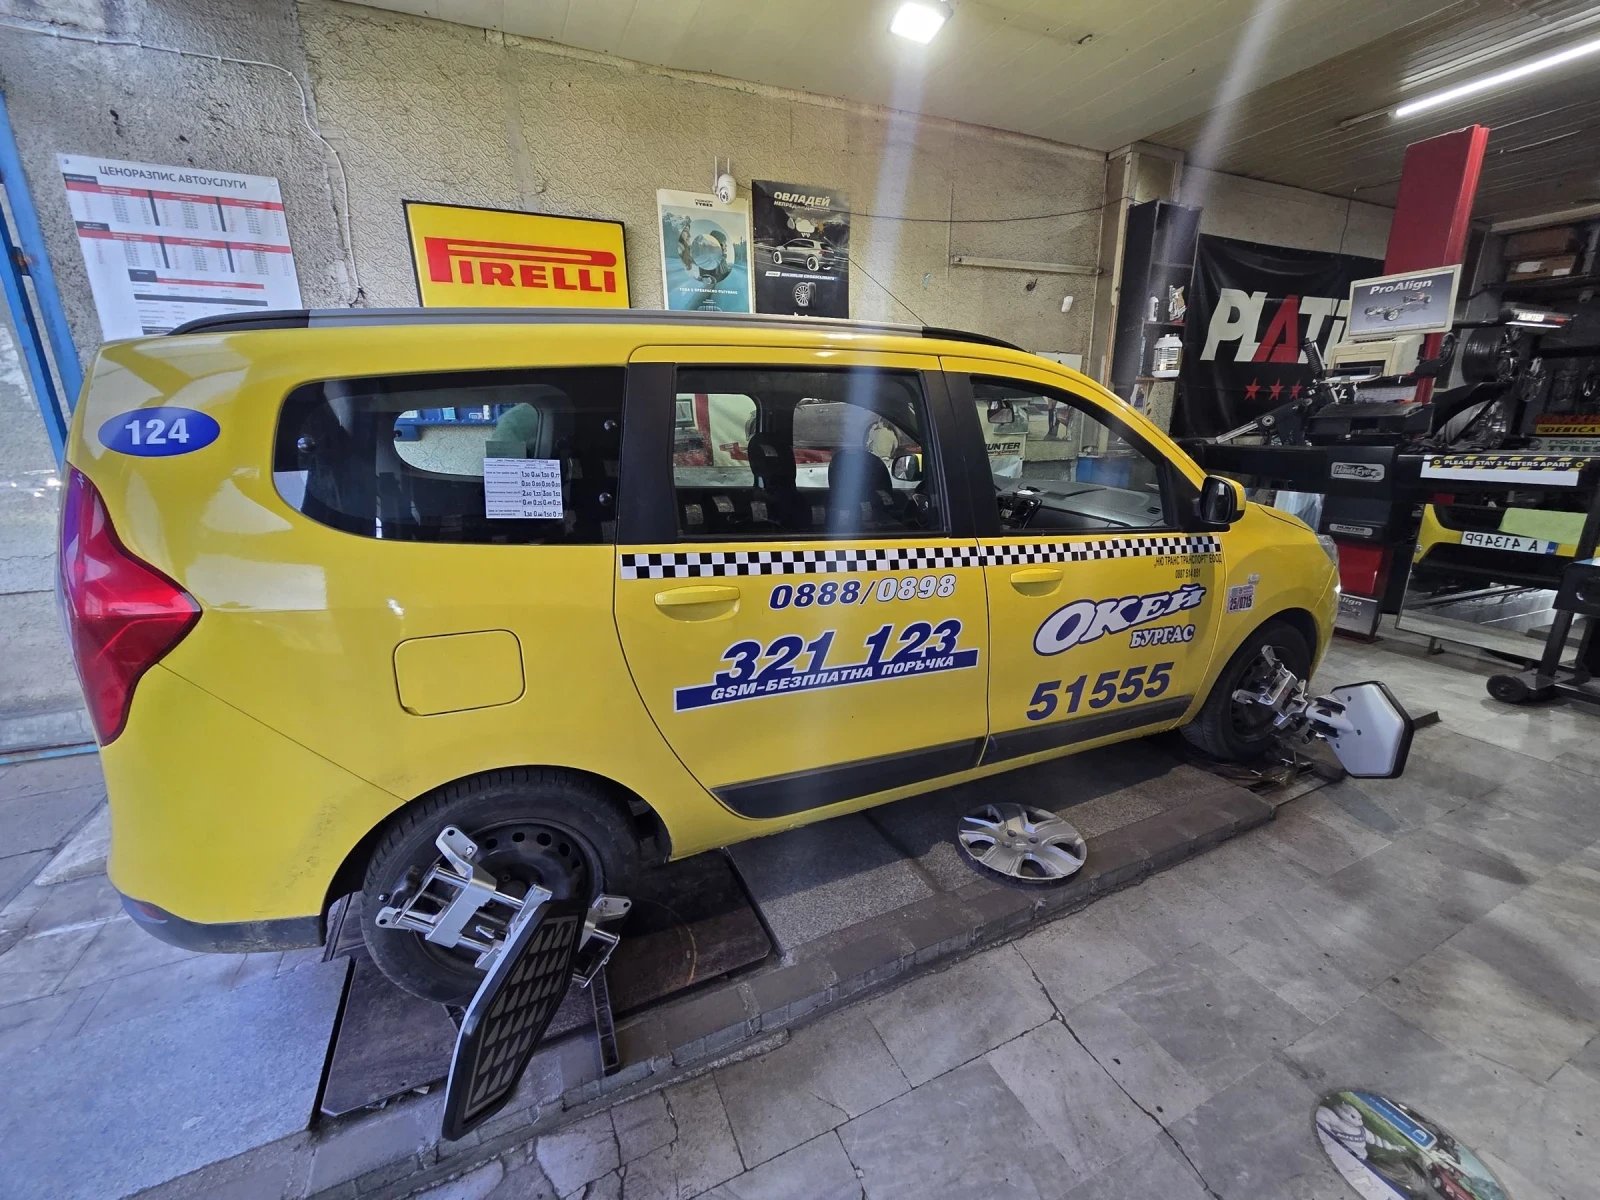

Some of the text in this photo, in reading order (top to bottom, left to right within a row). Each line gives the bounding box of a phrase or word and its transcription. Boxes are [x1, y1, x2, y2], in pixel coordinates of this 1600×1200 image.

[99, 166, 176, 182] ЦЕНОРАЗПИС
[178, 174, 247, 189] АВТОУСЛУГИ
[774, 191, 830, 207] ОВЛАДЕЙ
[424, 237, 617, 292] PIRELLI
[1369, 278, 1432, 295] ProAlign
[125, 418, 189, 445] 124
[1334, 465, 1371, 476] HawkEye
[1165, 556, 1180, 565] ТРАНС
[1209, 554, 1222, 564] ЕООД
[769, 574, 956, 610] 0888/0898
[1033, 583, 1206, 656] ОКЕЙ
[1129, 624, 1196, 648] БУРГАС
[714, 618, 962, 682] 321 123
[710, 655, 954, 701] GSM-БЕЗПЛАТНА ПОРЪЧКА
[1026, 662, 1175, 721] 51555
